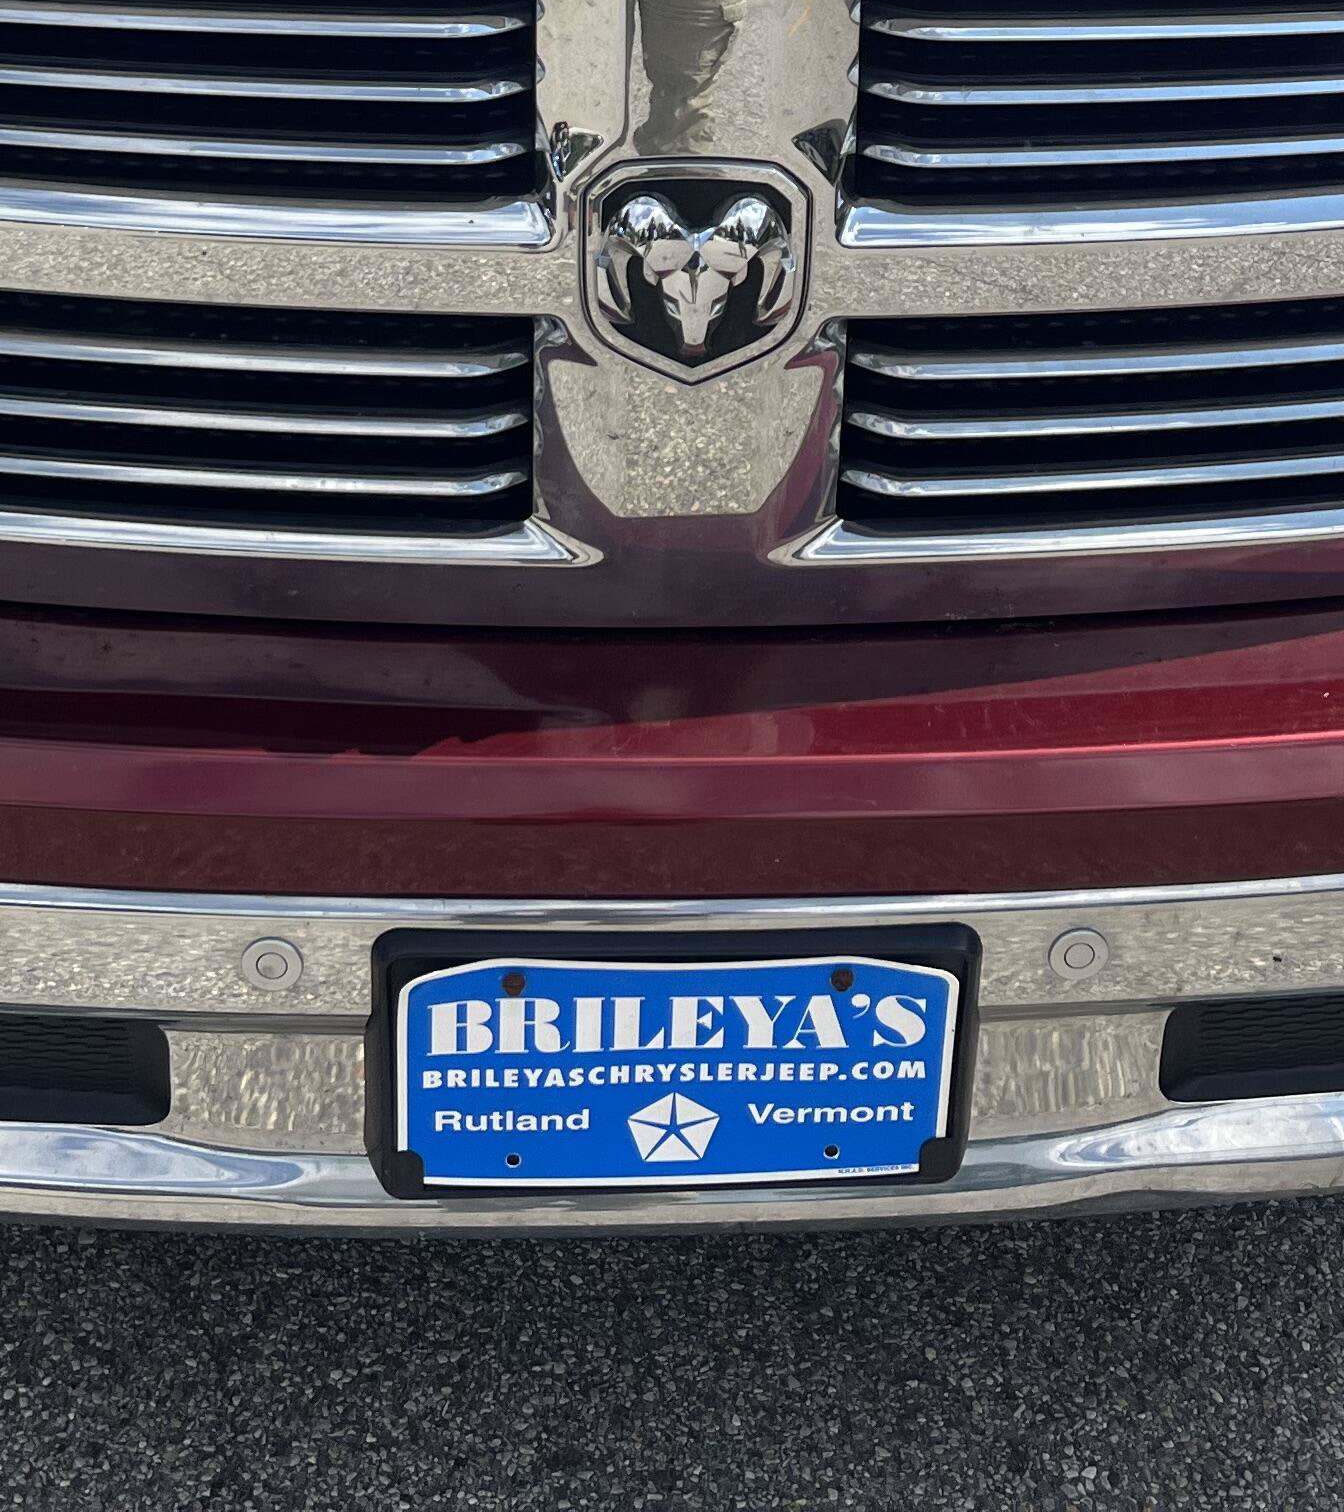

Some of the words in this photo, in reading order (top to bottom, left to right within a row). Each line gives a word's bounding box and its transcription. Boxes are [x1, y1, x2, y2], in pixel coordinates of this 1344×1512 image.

[426, 993, 928, 1057] BRILEYA'S
[422, 1059, 927, 1089] BRILEYASCHRYSLERJEEP.COM
[434, 1108, 591, 1133] Rutland
[747, 1100, 915, 1125] Vermont
